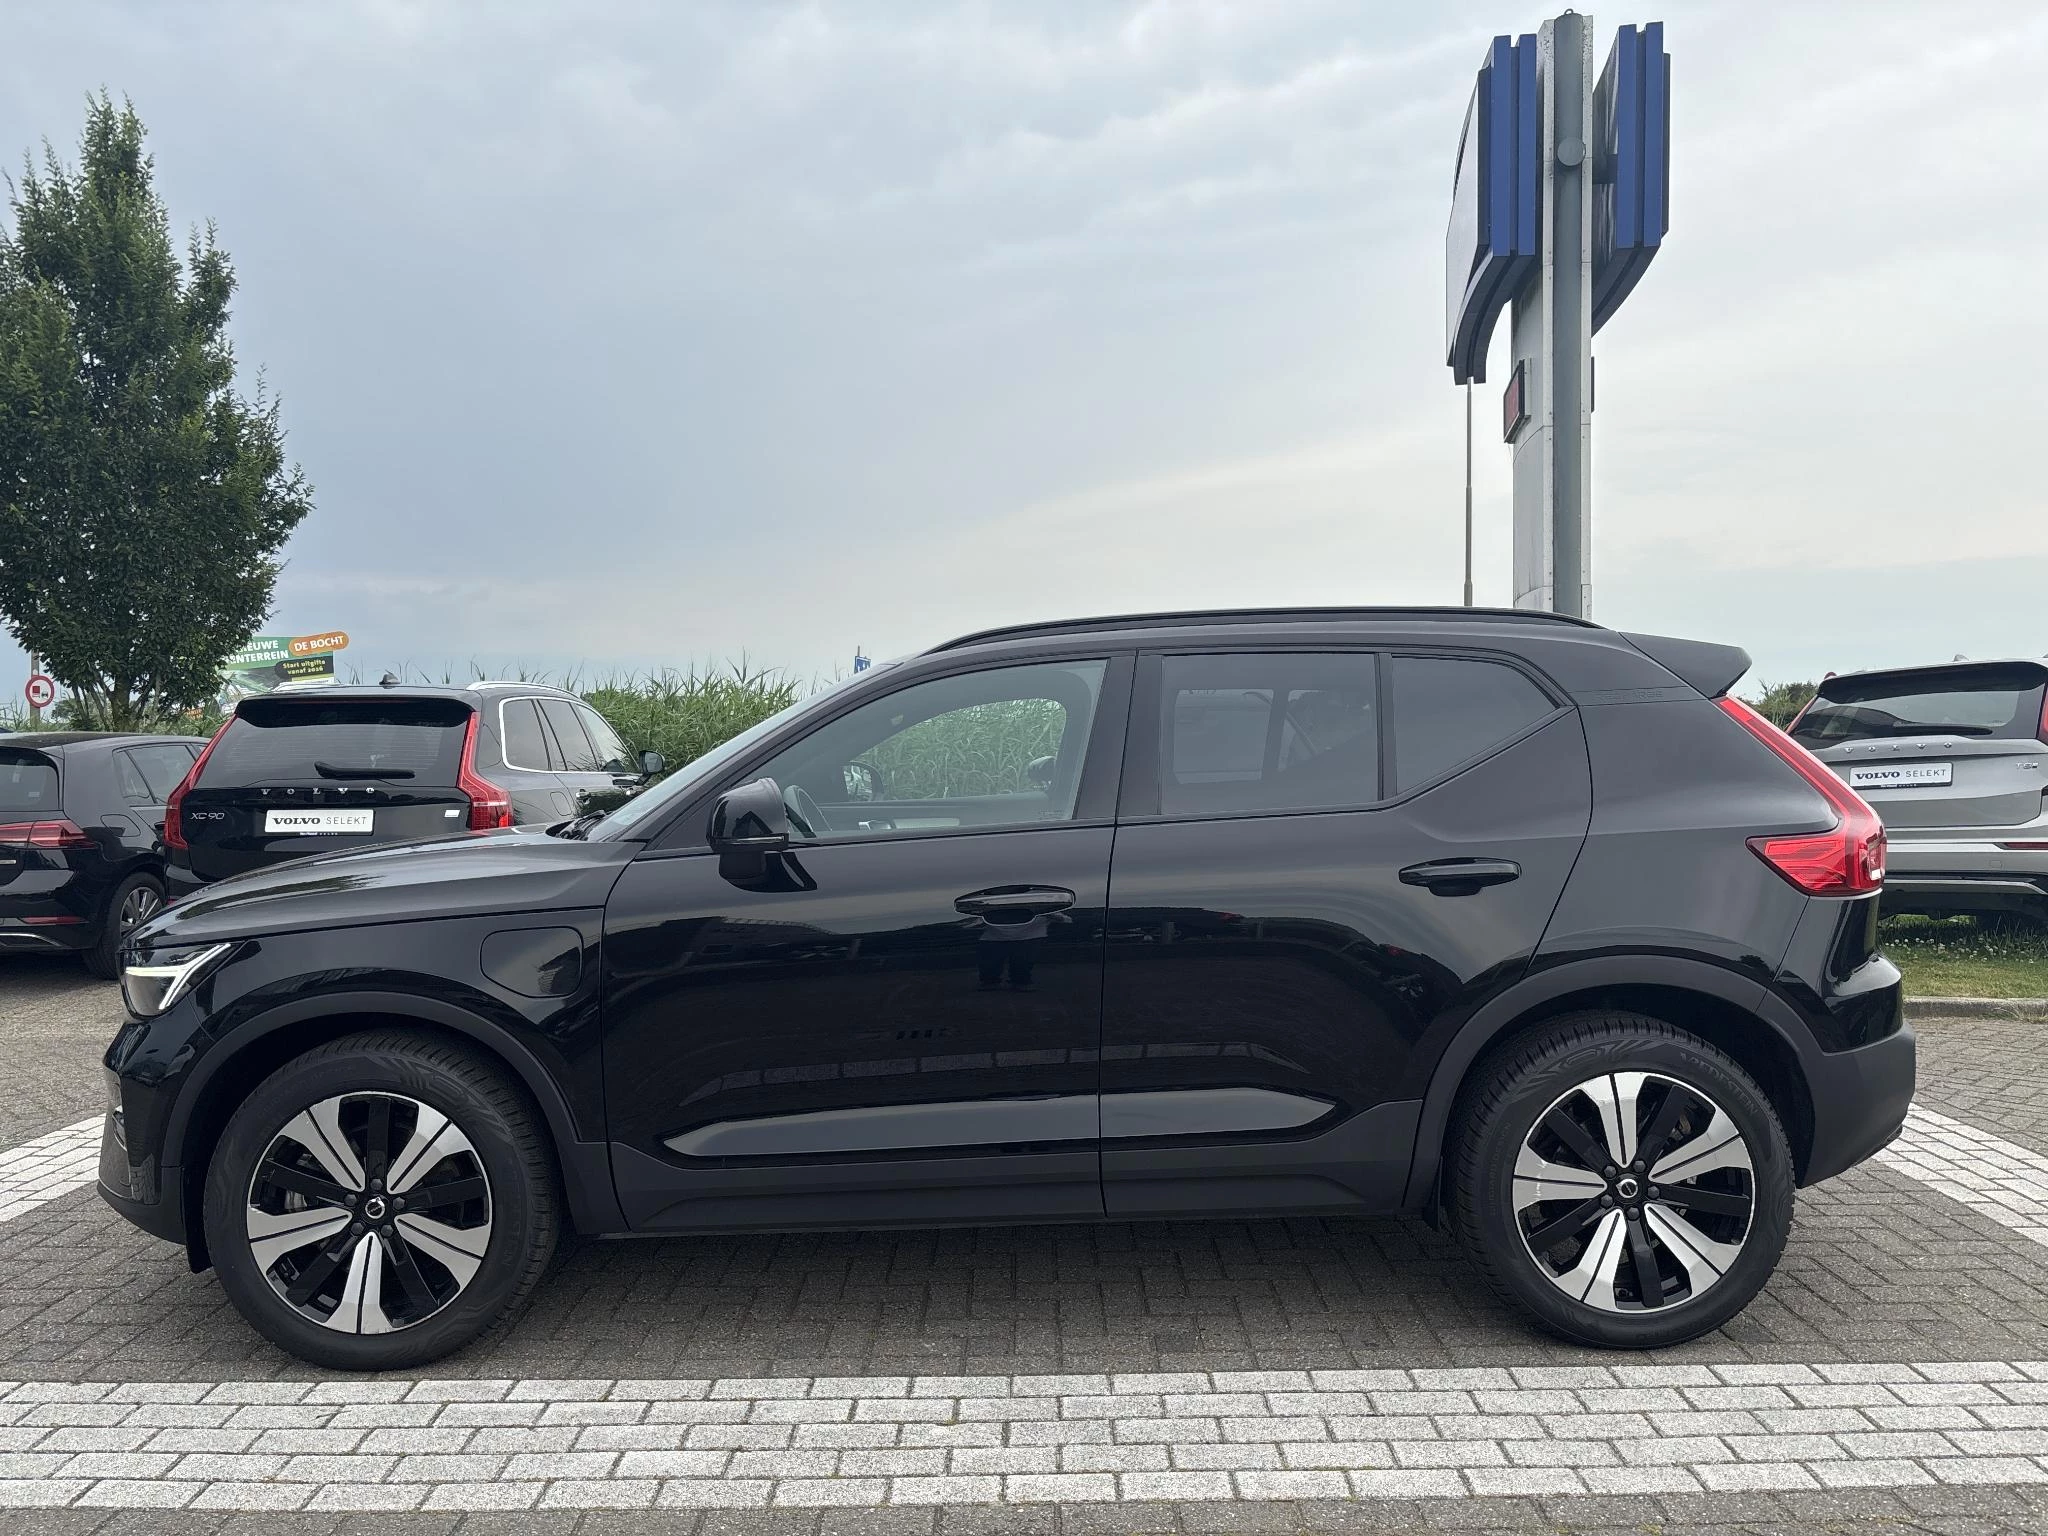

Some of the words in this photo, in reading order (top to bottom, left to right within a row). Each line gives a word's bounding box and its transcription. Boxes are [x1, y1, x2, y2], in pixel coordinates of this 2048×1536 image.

[294, 641, 308, 652] DE
[310, 635, 344, 649] BOCHT
[287, 667, 306, 675] vanaf
[1855, 771, 1901, 781] VOLVO
[1905, 769, 1947, 779] SELEKT
[260, 787, 375, 796] VOLVO
[189, 812, 225, 821] XC90
[271, 817, 321, 826] VOLVO
[326, 816, 368, 825] SELEKT
